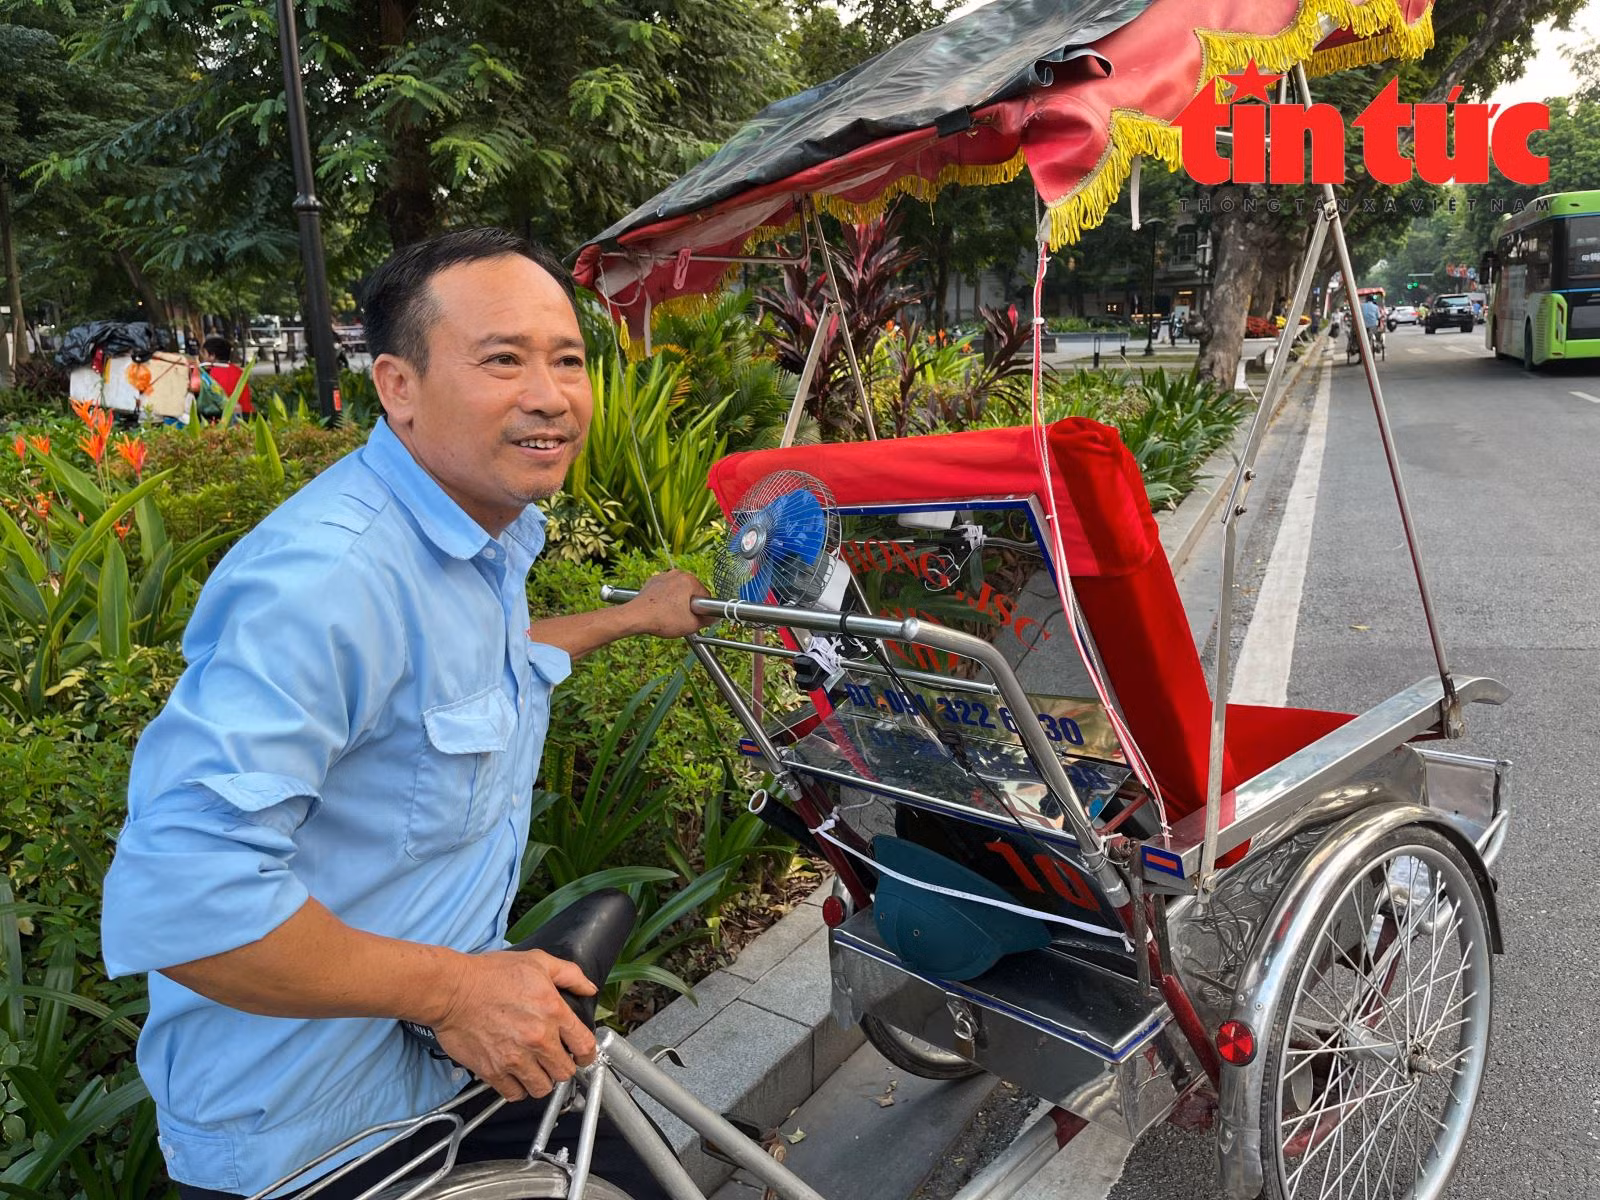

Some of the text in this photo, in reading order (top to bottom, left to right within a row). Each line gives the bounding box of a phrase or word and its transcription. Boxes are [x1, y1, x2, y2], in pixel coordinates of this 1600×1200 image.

[838, 535, 951, 589] HONG
[936, 696, 997, 730] 322
[998, 706, 1085, 746] 630
[985, 841, 1101, 912] 10
